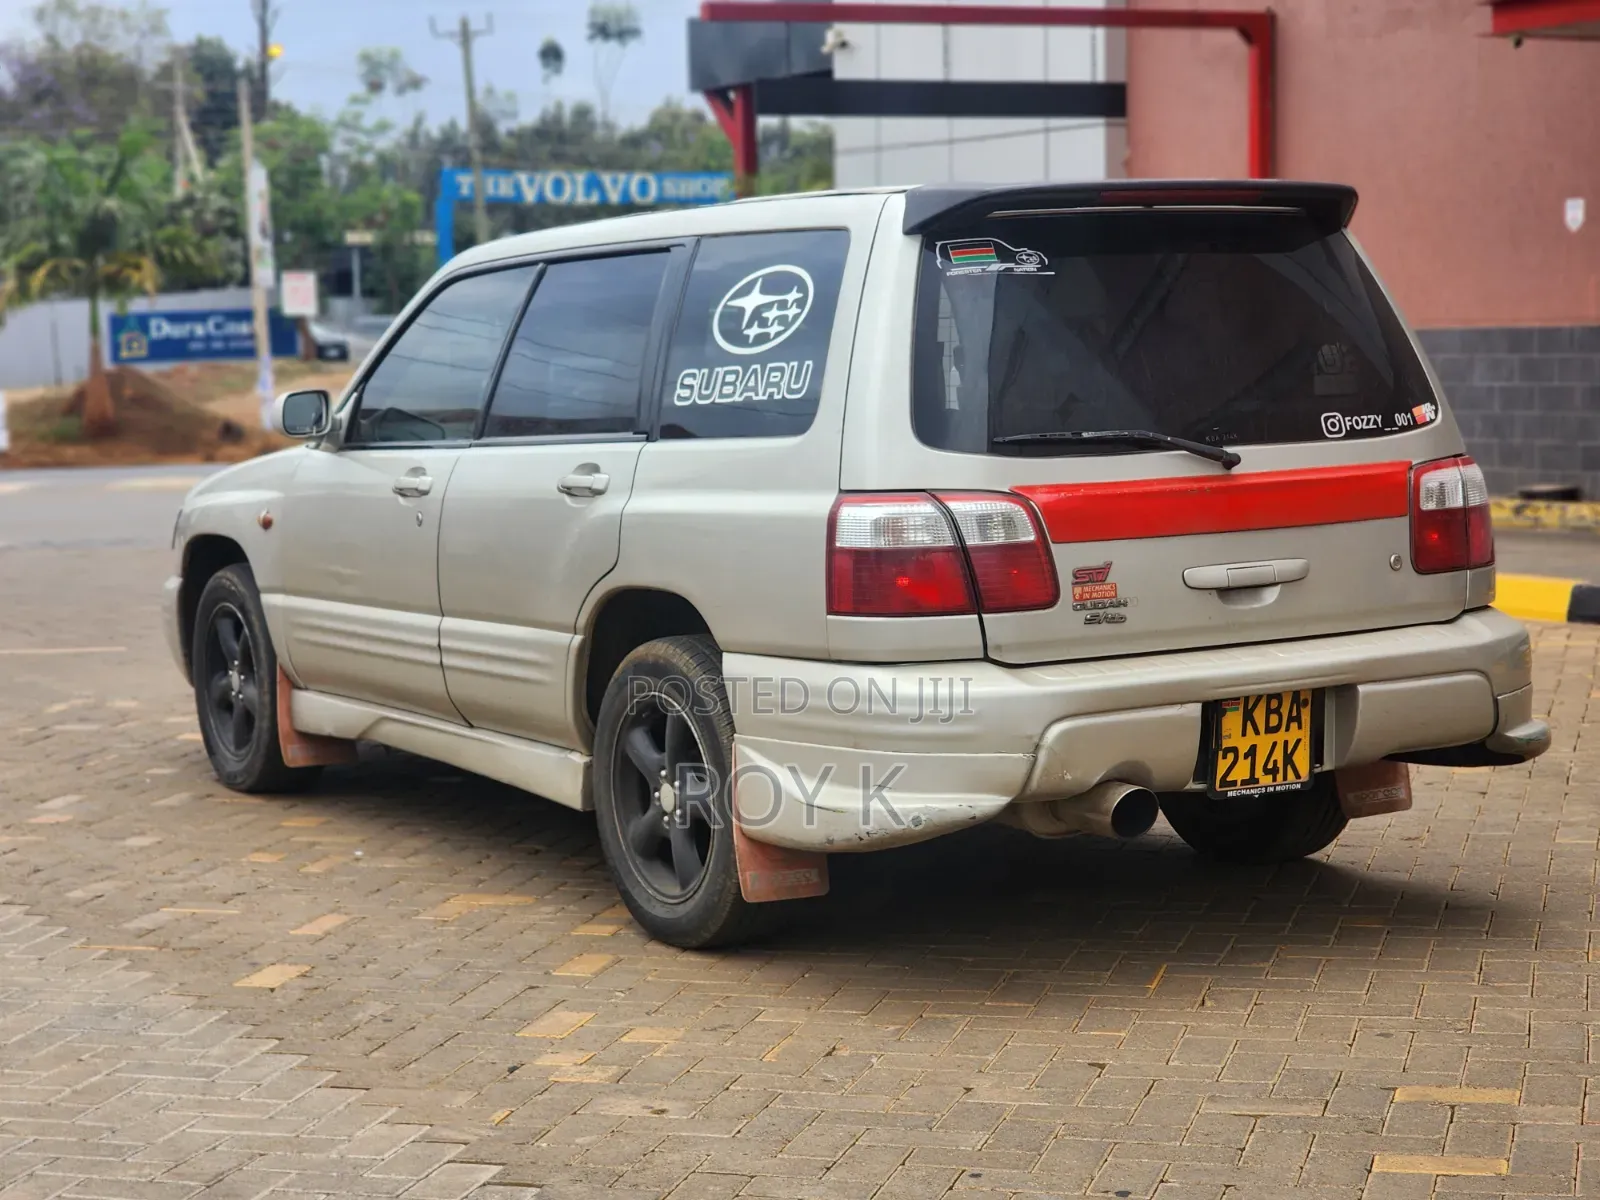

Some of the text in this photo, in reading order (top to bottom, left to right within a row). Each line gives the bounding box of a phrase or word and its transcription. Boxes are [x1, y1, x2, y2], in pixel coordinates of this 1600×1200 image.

[514, 170, 658, 204] VOLVO
[674, 360, 813, 406] SUBARU
[1082, 583, 1116, 592] MECHANICS
[1091, 590, 1115, 598] MOTION
[1219, 690, 1302, 788] KBA 214K
[1227, 786, 1266, 797] MECHANICS
[1275, 783, 1301, 792] MOTION
